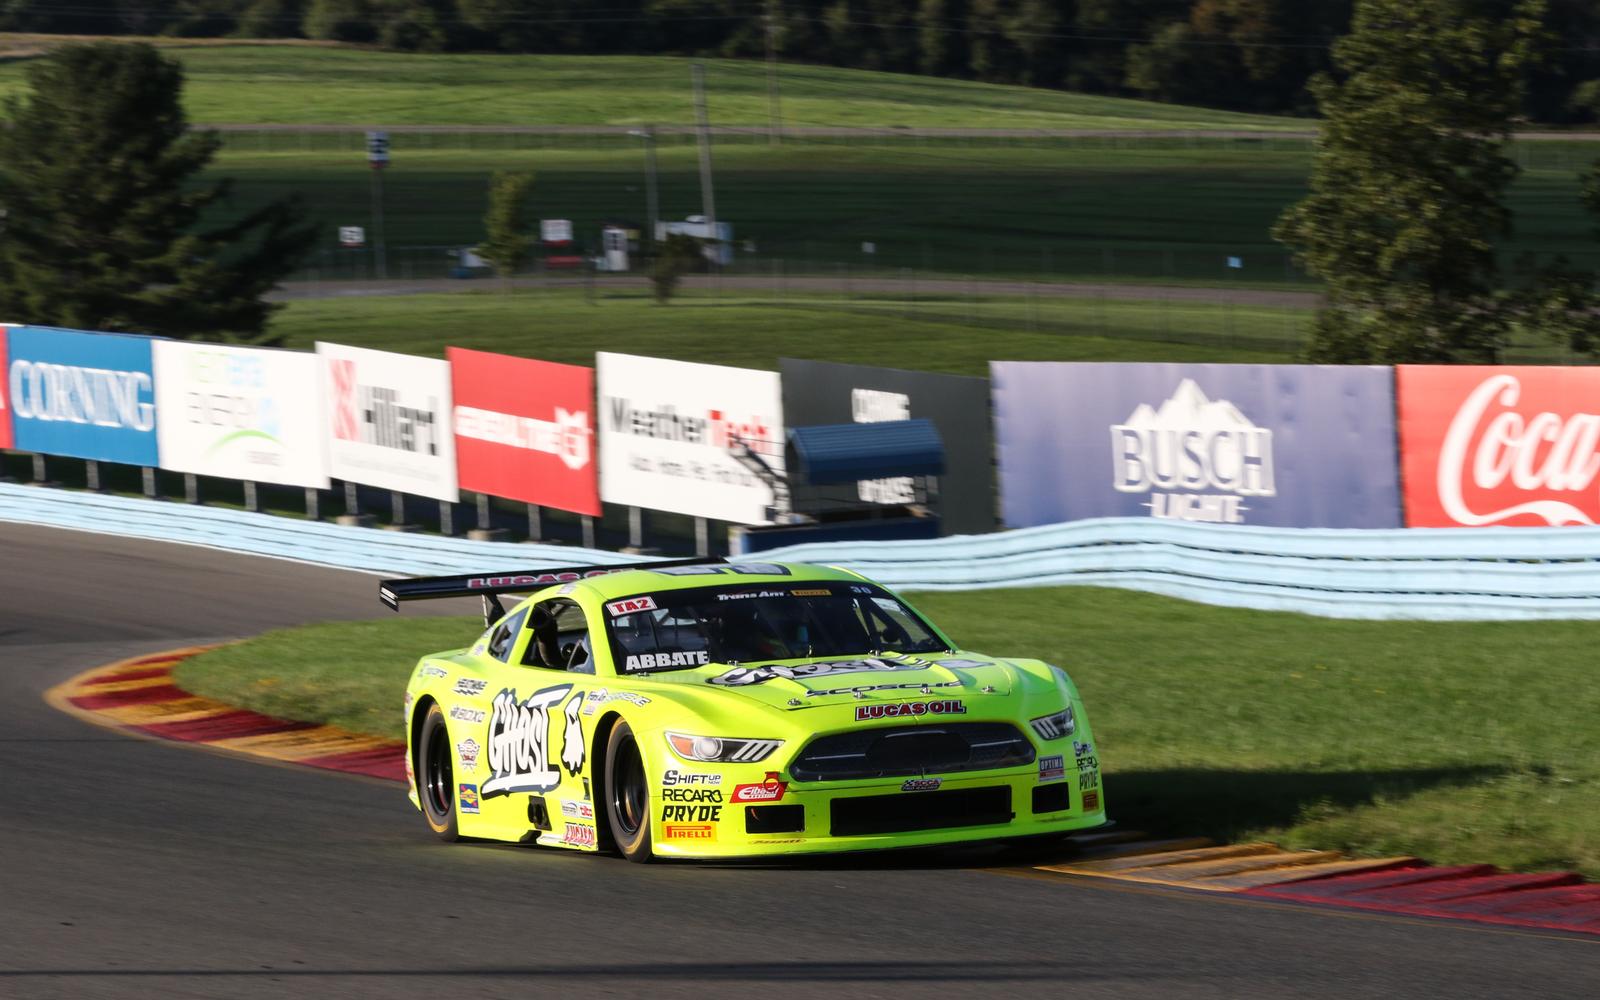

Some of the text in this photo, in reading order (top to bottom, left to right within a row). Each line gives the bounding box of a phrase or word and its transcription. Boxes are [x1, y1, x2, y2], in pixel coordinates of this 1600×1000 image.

[9, 359, 154, 432] CORNING
[1110, 424, 1277, 497] BUSCH
[1150, 494, 1246, 523] LIGHT
[468, 572, 580, 588] LUCAS
[612, 599, 651, 613] TA2
[626, 650, 709, 671] ABBATE
[856, 700, 966, 721] LUCAS OIL
[662, 788, 724, 803] RECARO
[661, 805, 722, 822] PRYDE
[666, 825, 711, 838] PIRELLI
